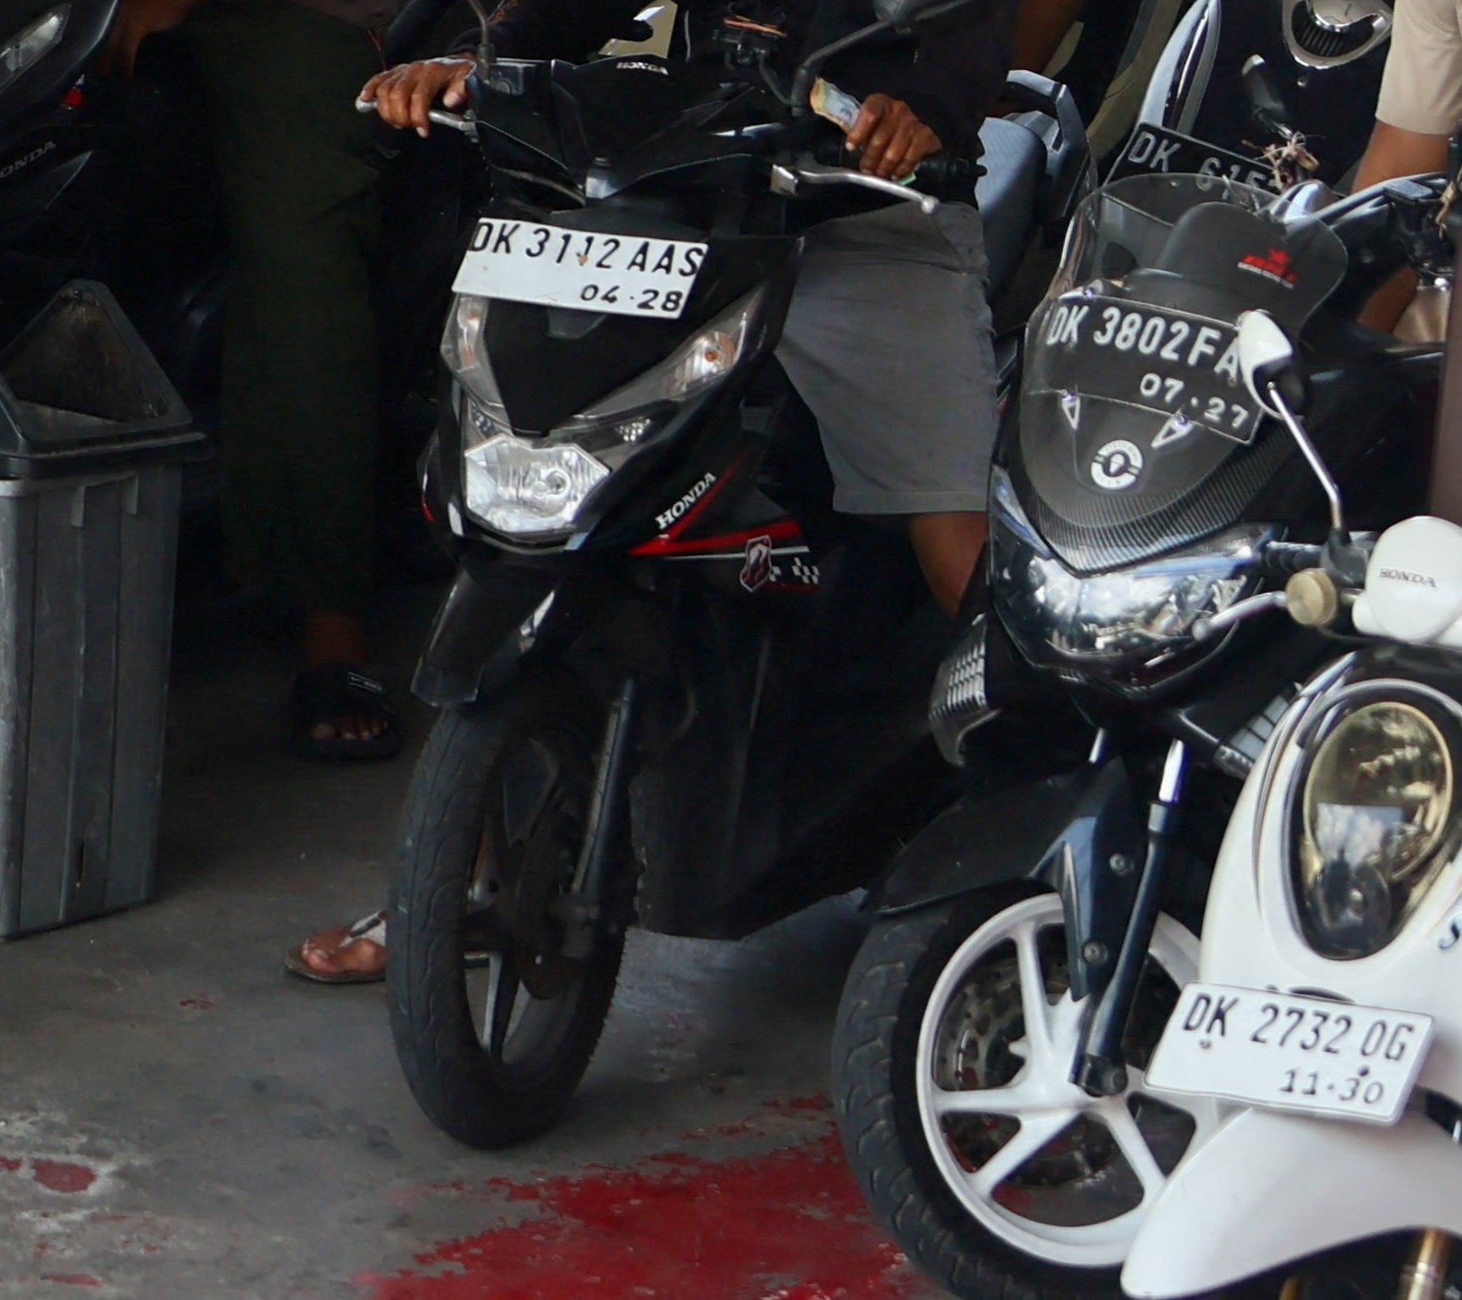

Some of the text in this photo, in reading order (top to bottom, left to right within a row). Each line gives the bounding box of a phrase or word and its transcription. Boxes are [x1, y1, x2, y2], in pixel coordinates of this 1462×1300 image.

[1127, 127, 1182, 173] DK
[471, 221, 700, 278] DK 3112 AAS
[1046, 304, 1084, 343] DK
[1101, 305, 1188, 362] 3802
[655, 472, 717, 530] HONDA
[1377, 568, 1435, 589] HONDA
[1181, 995, 1353, 1057] DK 2732
